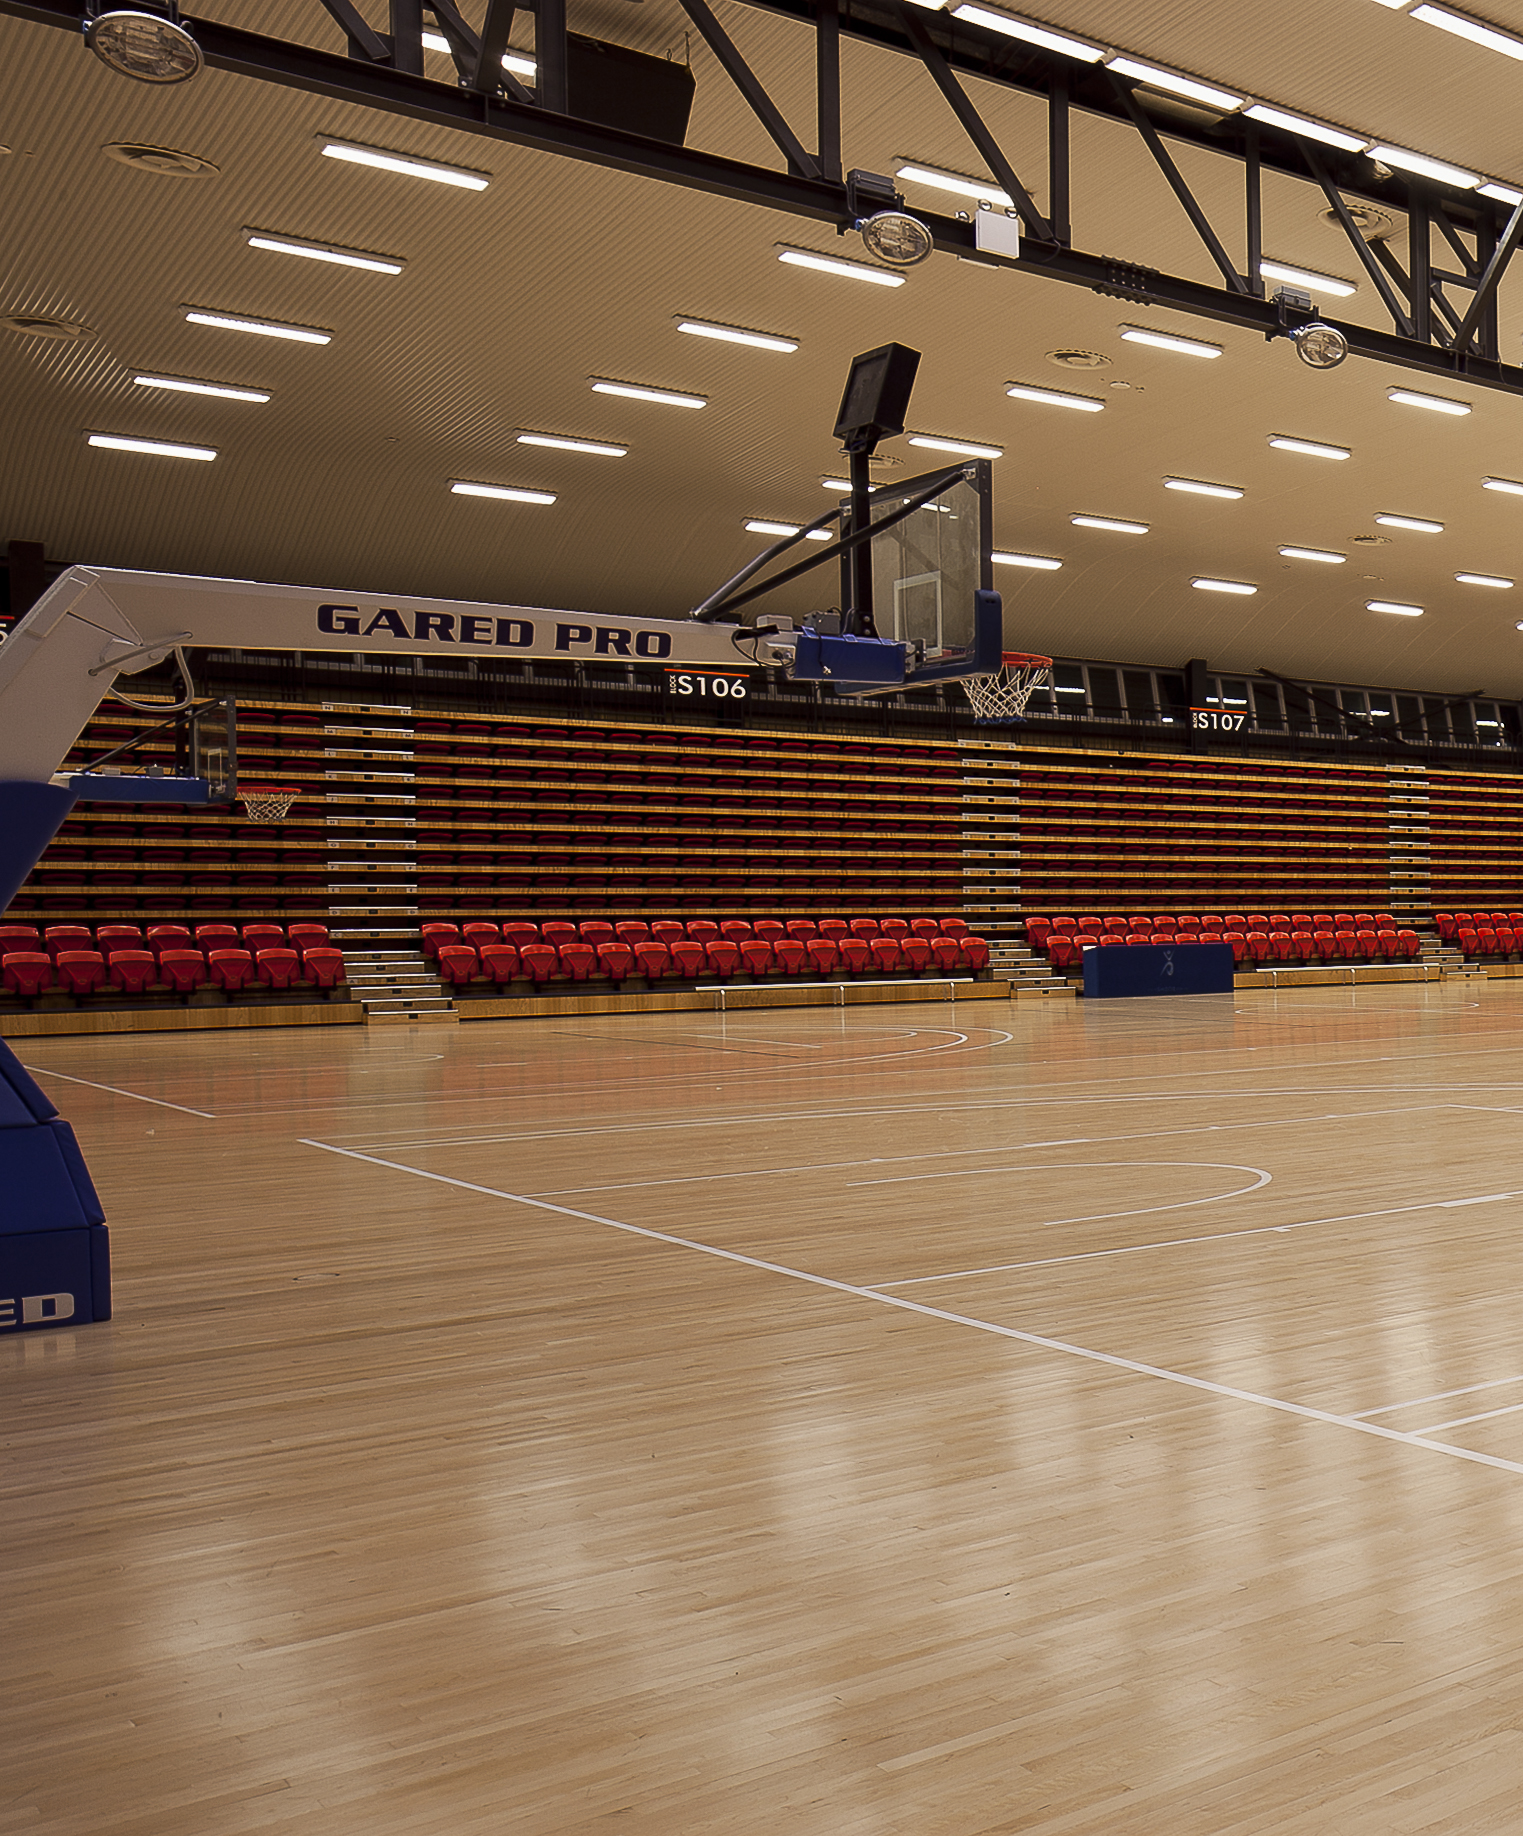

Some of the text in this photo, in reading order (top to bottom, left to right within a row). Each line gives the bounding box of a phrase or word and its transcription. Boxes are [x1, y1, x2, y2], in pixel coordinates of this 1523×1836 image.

[317, 602, 673, 659] GARED PRO
[678, 675, 747, 699] S106
[1198, 712, 1245, 732] S107
